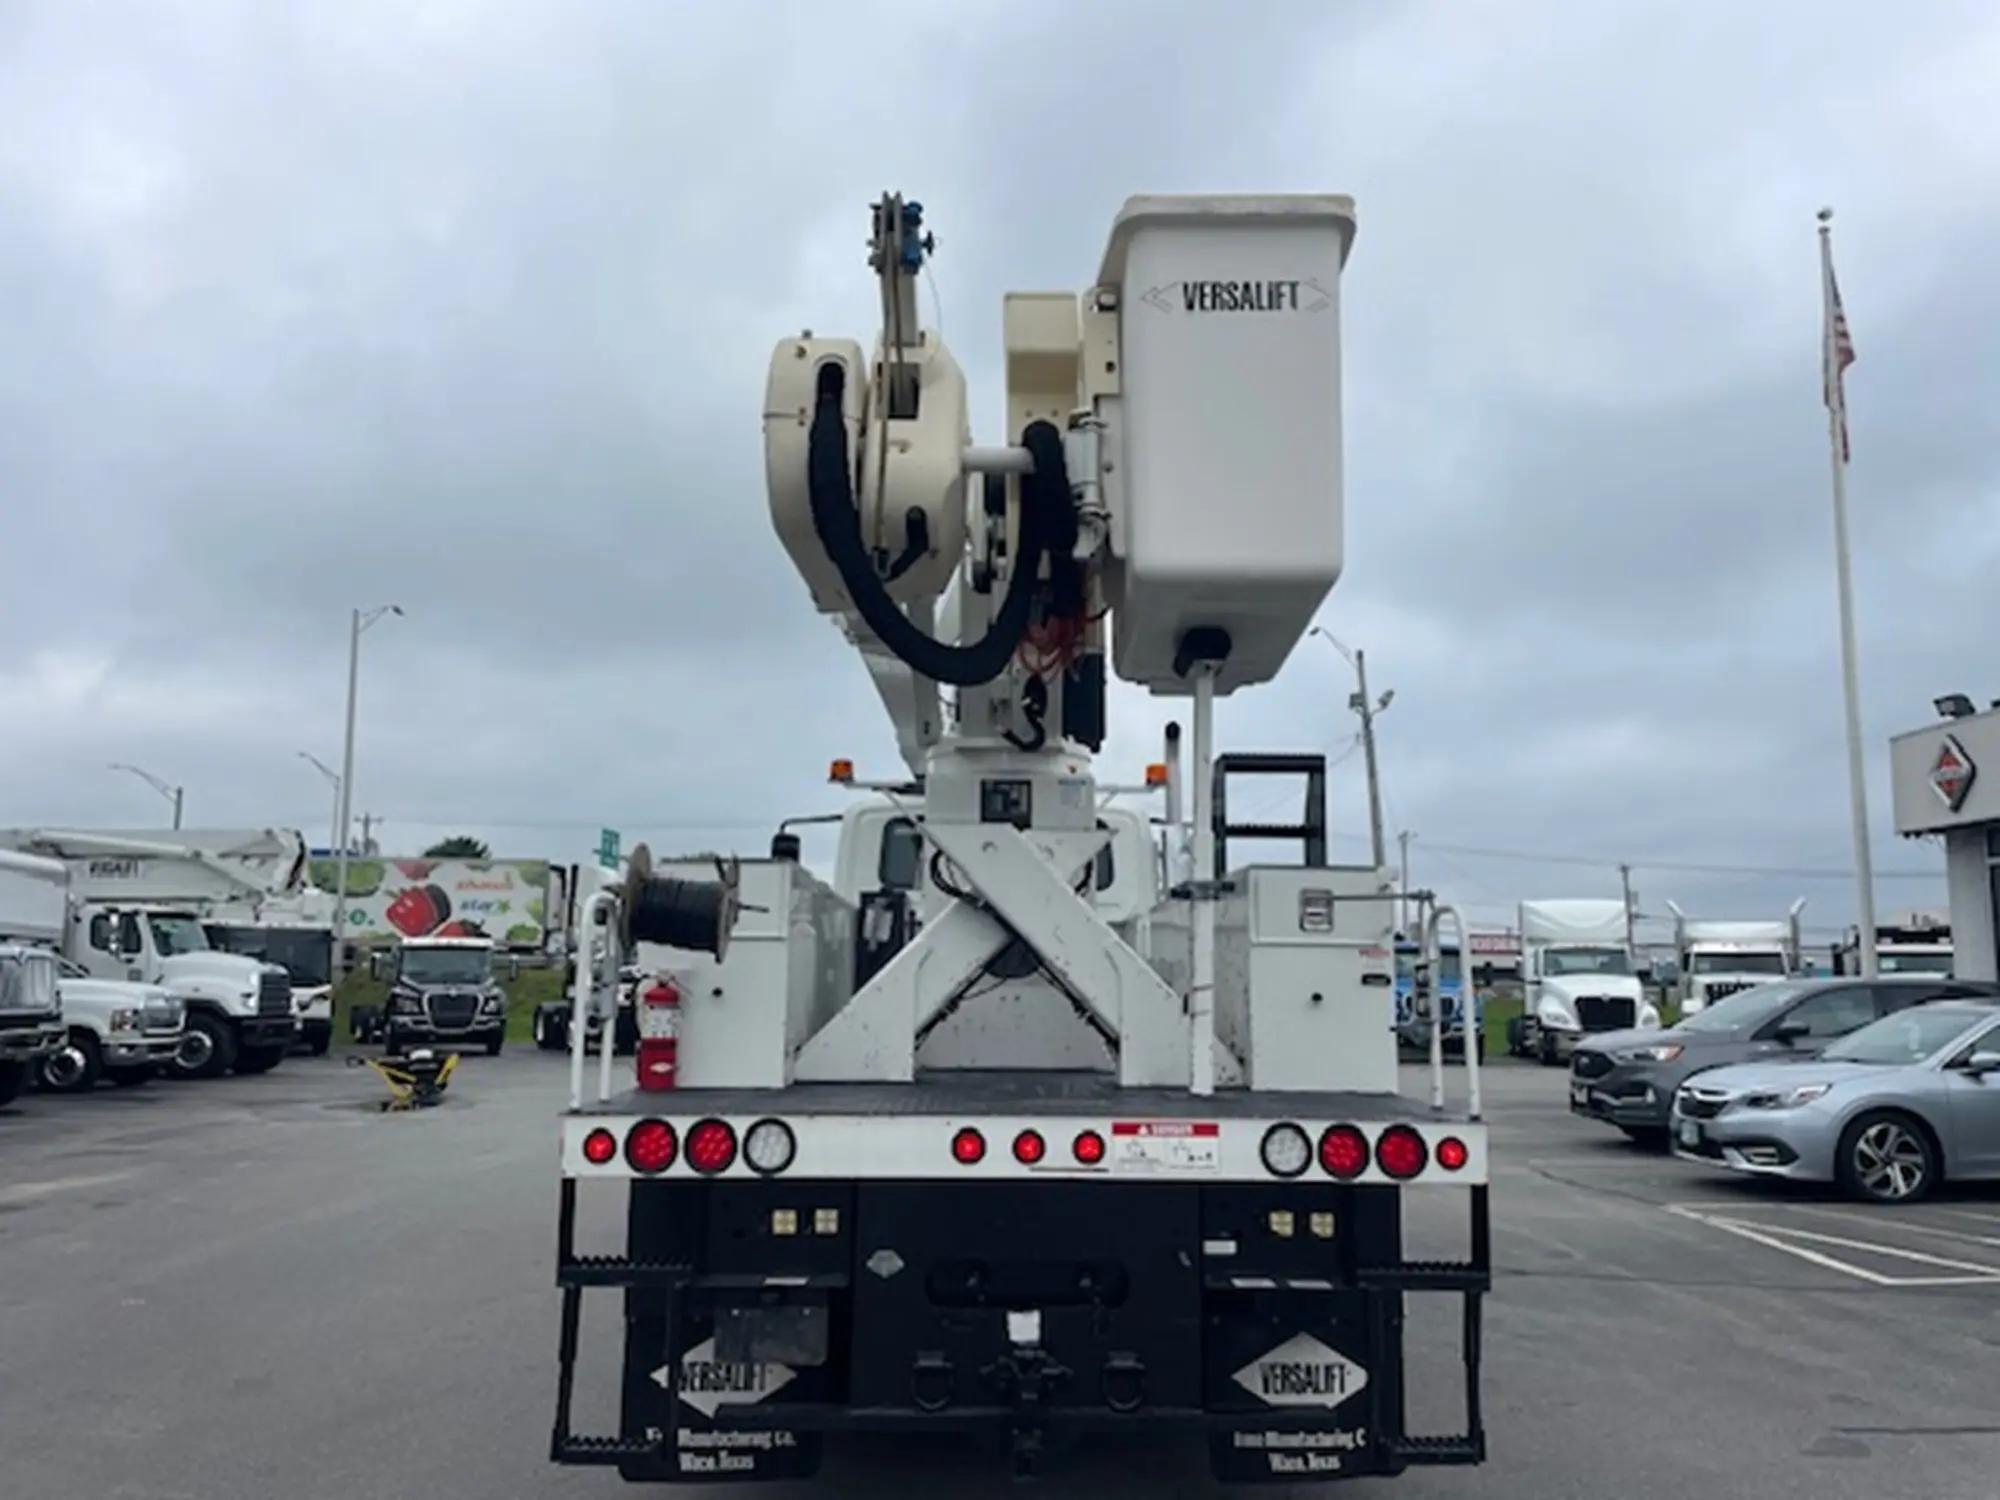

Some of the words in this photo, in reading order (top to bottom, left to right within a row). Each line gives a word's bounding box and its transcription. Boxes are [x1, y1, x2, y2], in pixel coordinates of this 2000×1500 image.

[1182, 281, 1299, 312] VERSALIFT
[1259, 1362, 1346, 1395] VERSALIFT
[677, 1427, 772, 1450] Manufacturing
[1265, 1429, 1355, 1450] Manufacturing
[719, 1450, 754, 1470] Texas
[1307, 1452, 1341, 1471] Texas
